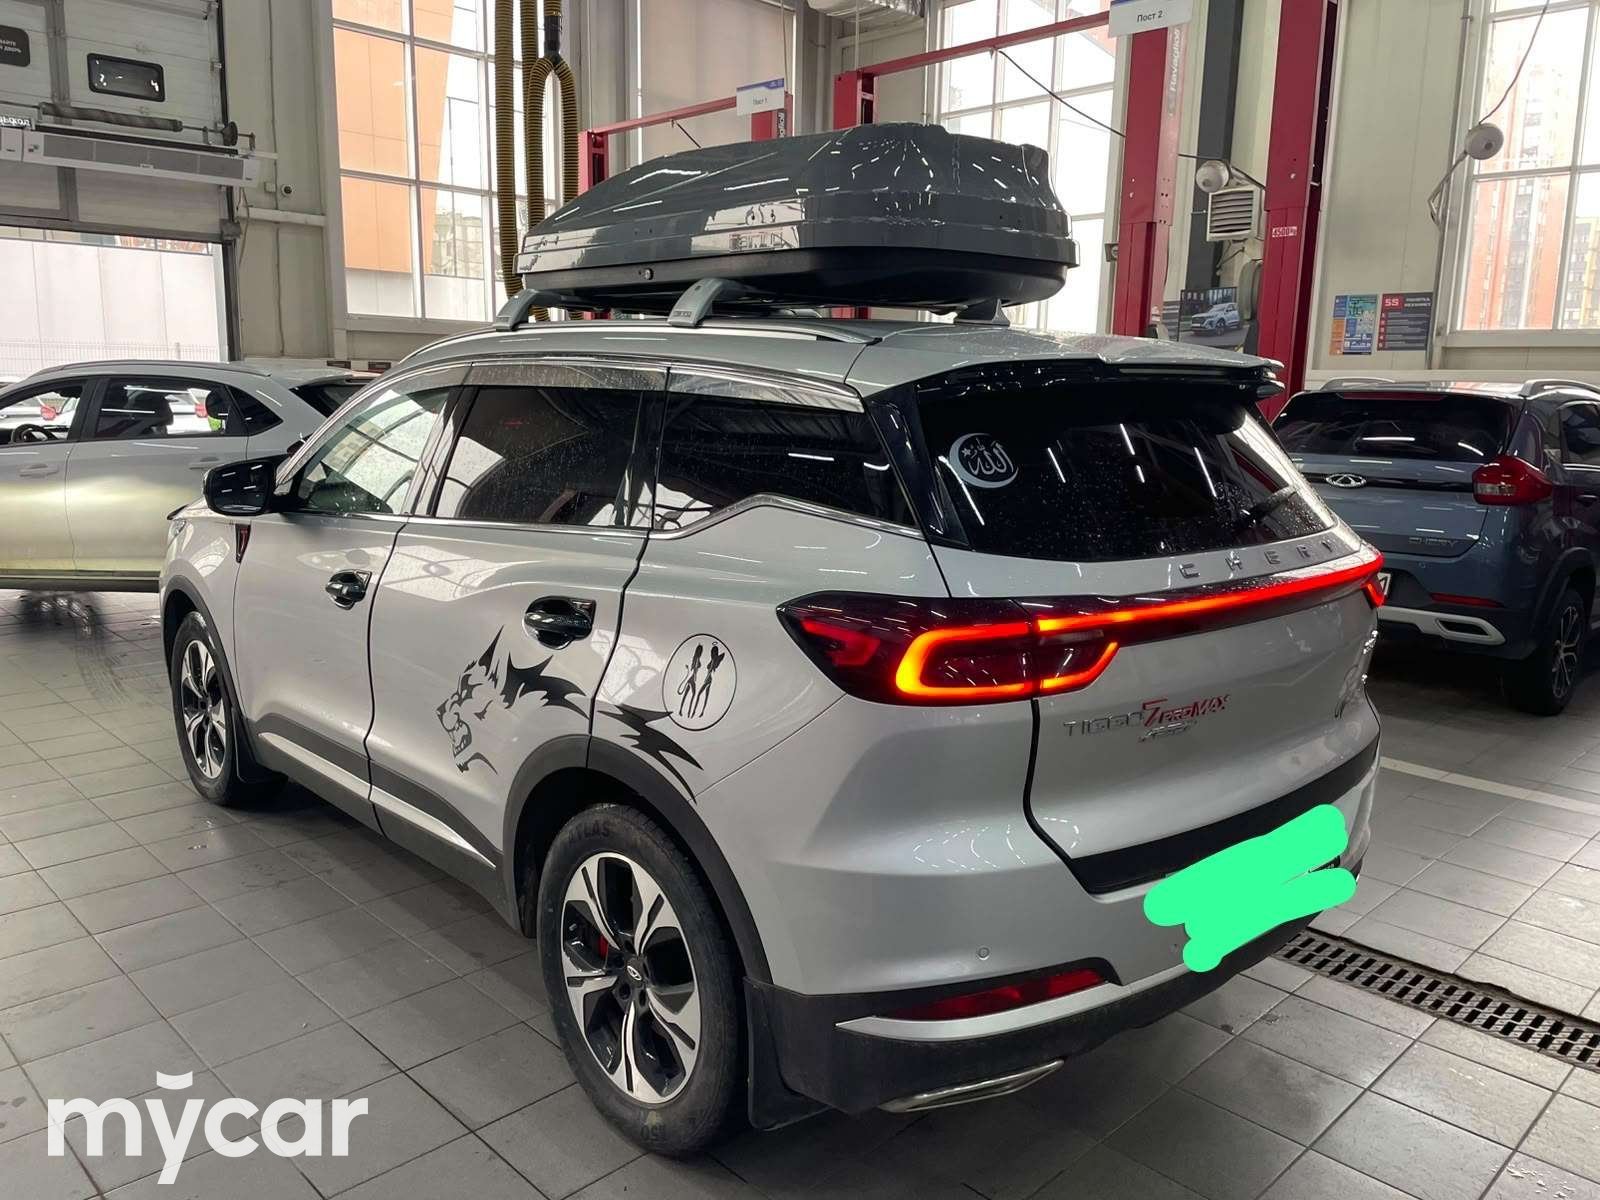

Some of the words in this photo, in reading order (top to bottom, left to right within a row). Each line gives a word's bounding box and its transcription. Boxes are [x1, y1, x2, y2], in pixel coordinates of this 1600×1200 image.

[1136, 13, 1157, 23] Пост
[1157, 10, 1163, 19] 2
[1178, 539, 1335, 579] CHERY
